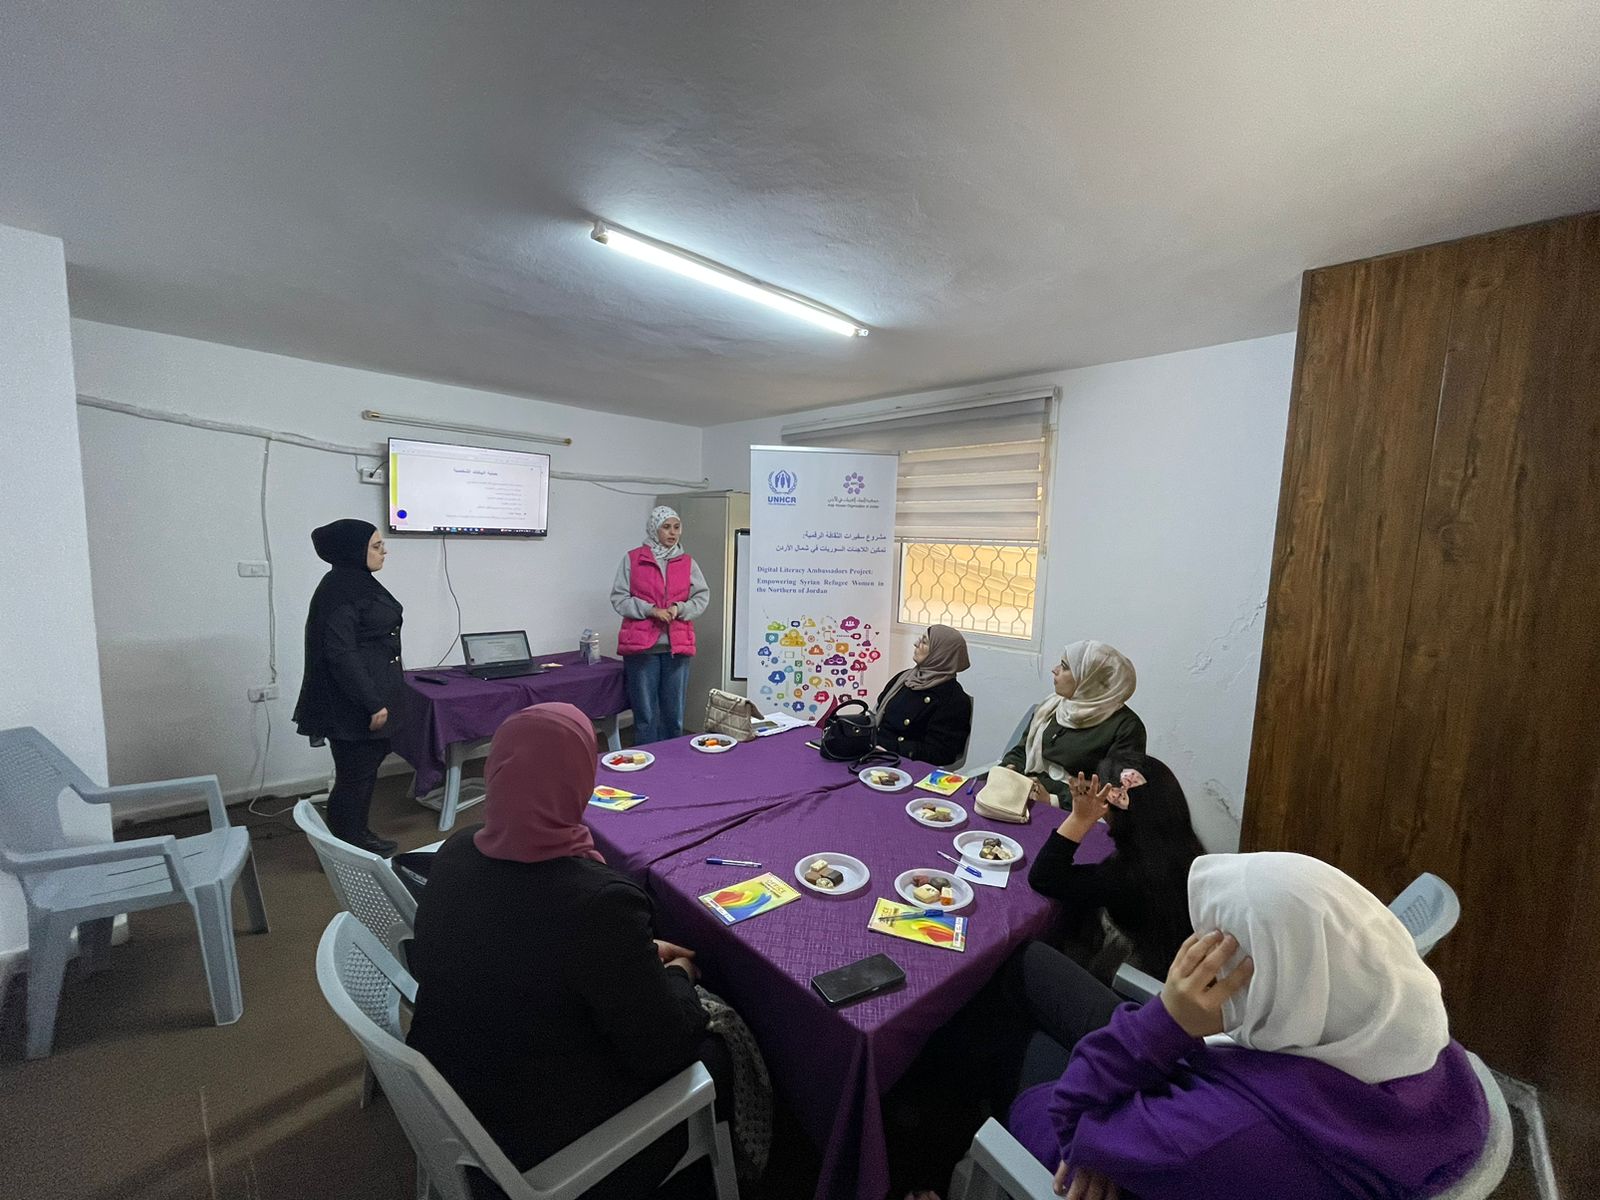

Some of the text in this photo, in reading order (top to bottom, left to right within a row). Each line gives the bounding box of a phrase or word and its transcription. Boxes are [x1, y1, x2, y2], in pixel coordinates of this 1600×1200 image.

[826, 530, 843, 539] الثقافة
[844, 531, 866, 540] سفيرات
[866, 531, 887, 541] مشروع
[795, 543, 809, 552] شمال
[810, 545, 819, 553] في
[820, 544, 846, 553] السوريات
[870, 546, 887, 554] تمكين
[779, 566, 805, 574] Literacy
[757, 578, 797, 586] Empowering
